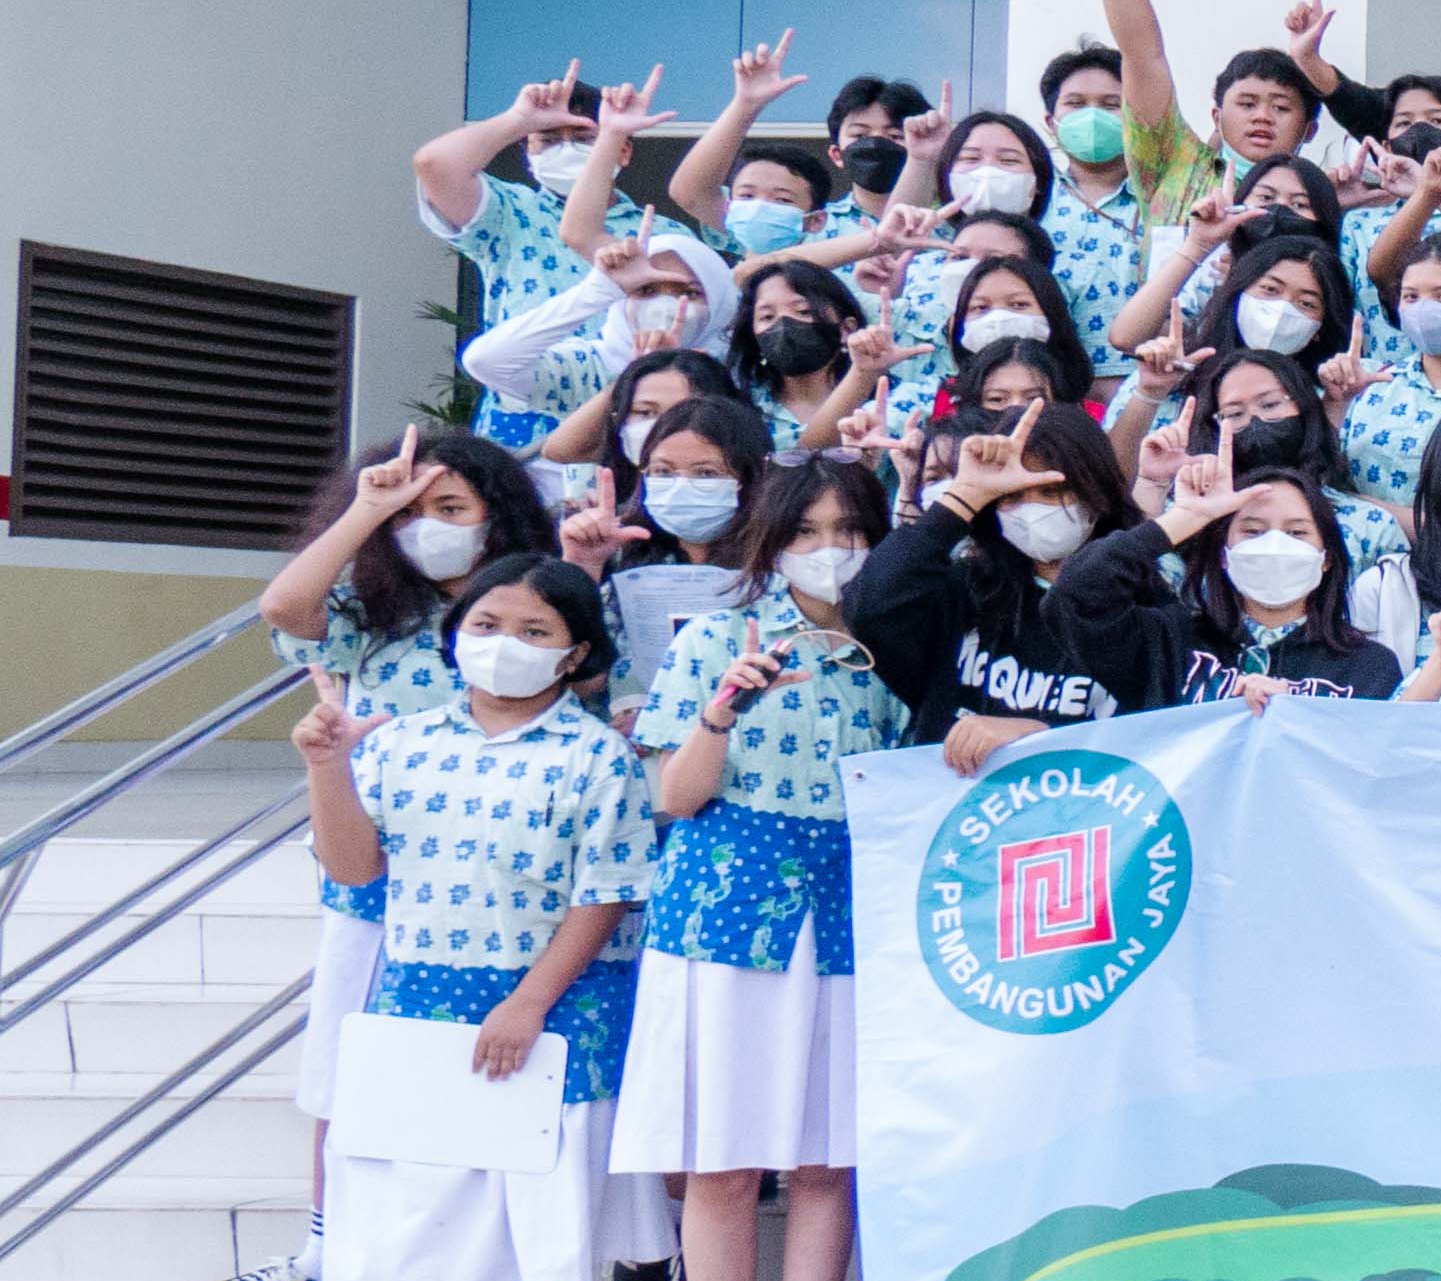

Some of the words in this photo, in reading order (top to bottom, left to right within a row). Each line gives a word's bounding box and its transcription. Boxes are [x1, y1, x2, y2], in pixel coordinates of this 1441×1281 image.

[959, 767, 1143, 845] SEKOLAH
[932, 881, 1146, 1018] PEMBANGUNAN
[1143, 832, 1175, 928] JAYA
